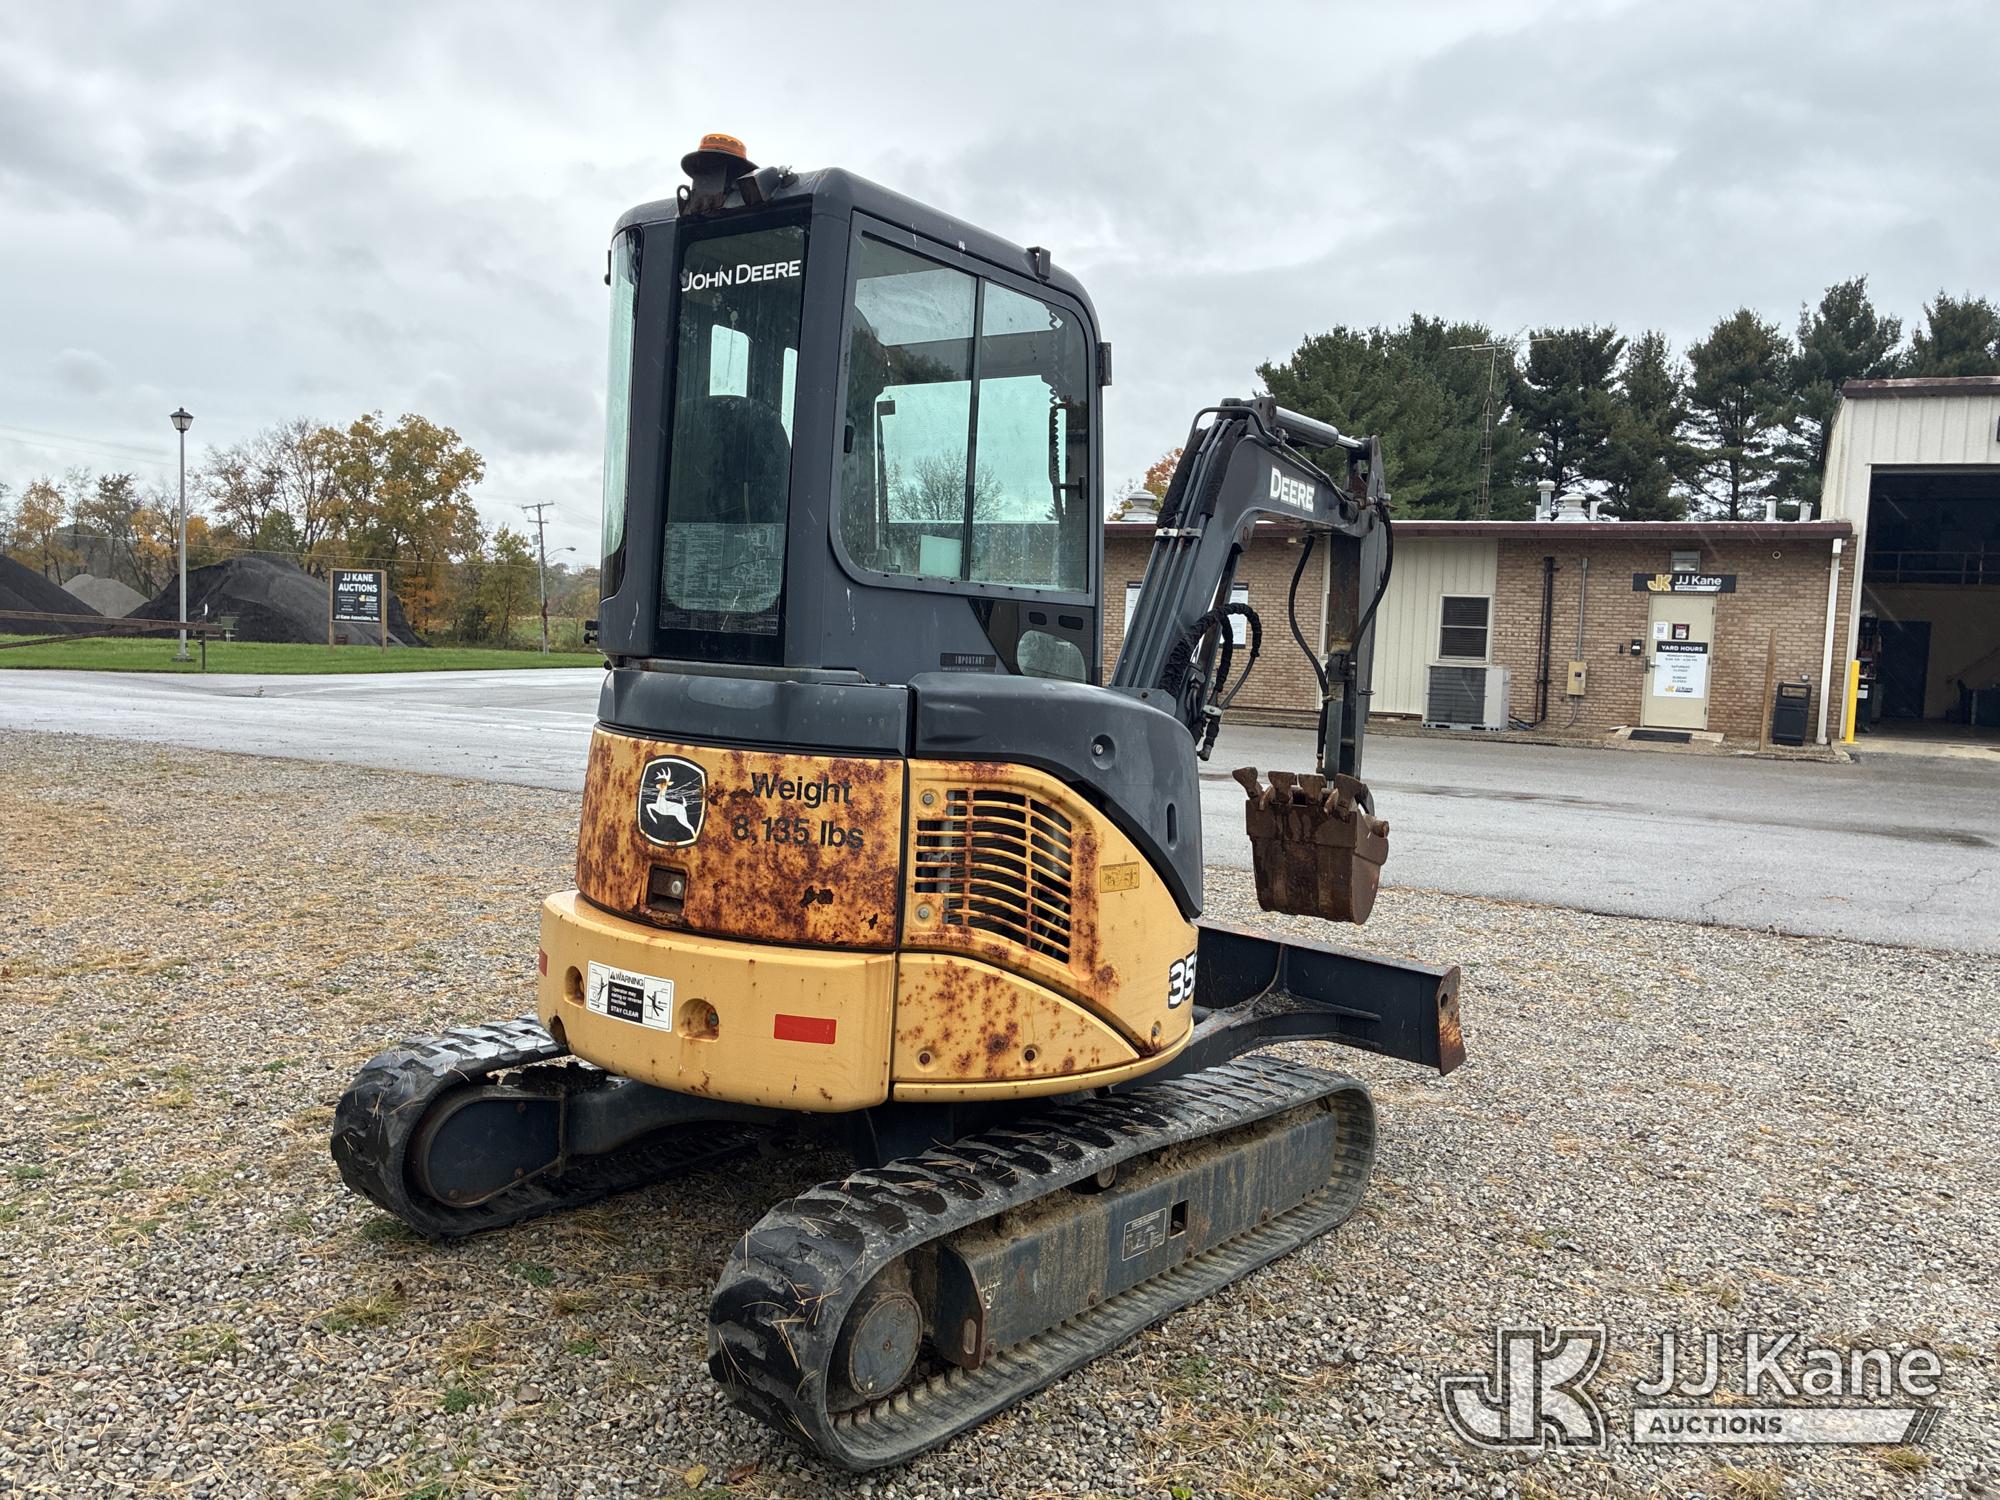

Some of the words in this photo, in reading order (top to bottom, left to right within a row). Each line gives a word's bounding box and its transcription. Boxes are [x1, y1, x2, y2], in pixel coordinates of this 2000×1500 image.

[681, 269, 732, 292] JOHN
[735, 259, 802, 285] DEERE
[1269, 466, 1316, 513] DEERE
[342, 572, 351, 582] JJ
[352, 573, 374, 582] KANE
[1675, 575, 1690, 585] JJ
[1691, 575, 1722, 586] Kane
[338, 583, 378, 593] AUCTIONS
[751, 772, 853, 809] Weight
[732, 814, 810, 846] 8,135
[820, 819, 865, 849] lbs
[615, 971, 644, 987] WARNING
[610, 1005, 623, 1014] STAY
[622, 1008, 640, 1018] CLEAR
